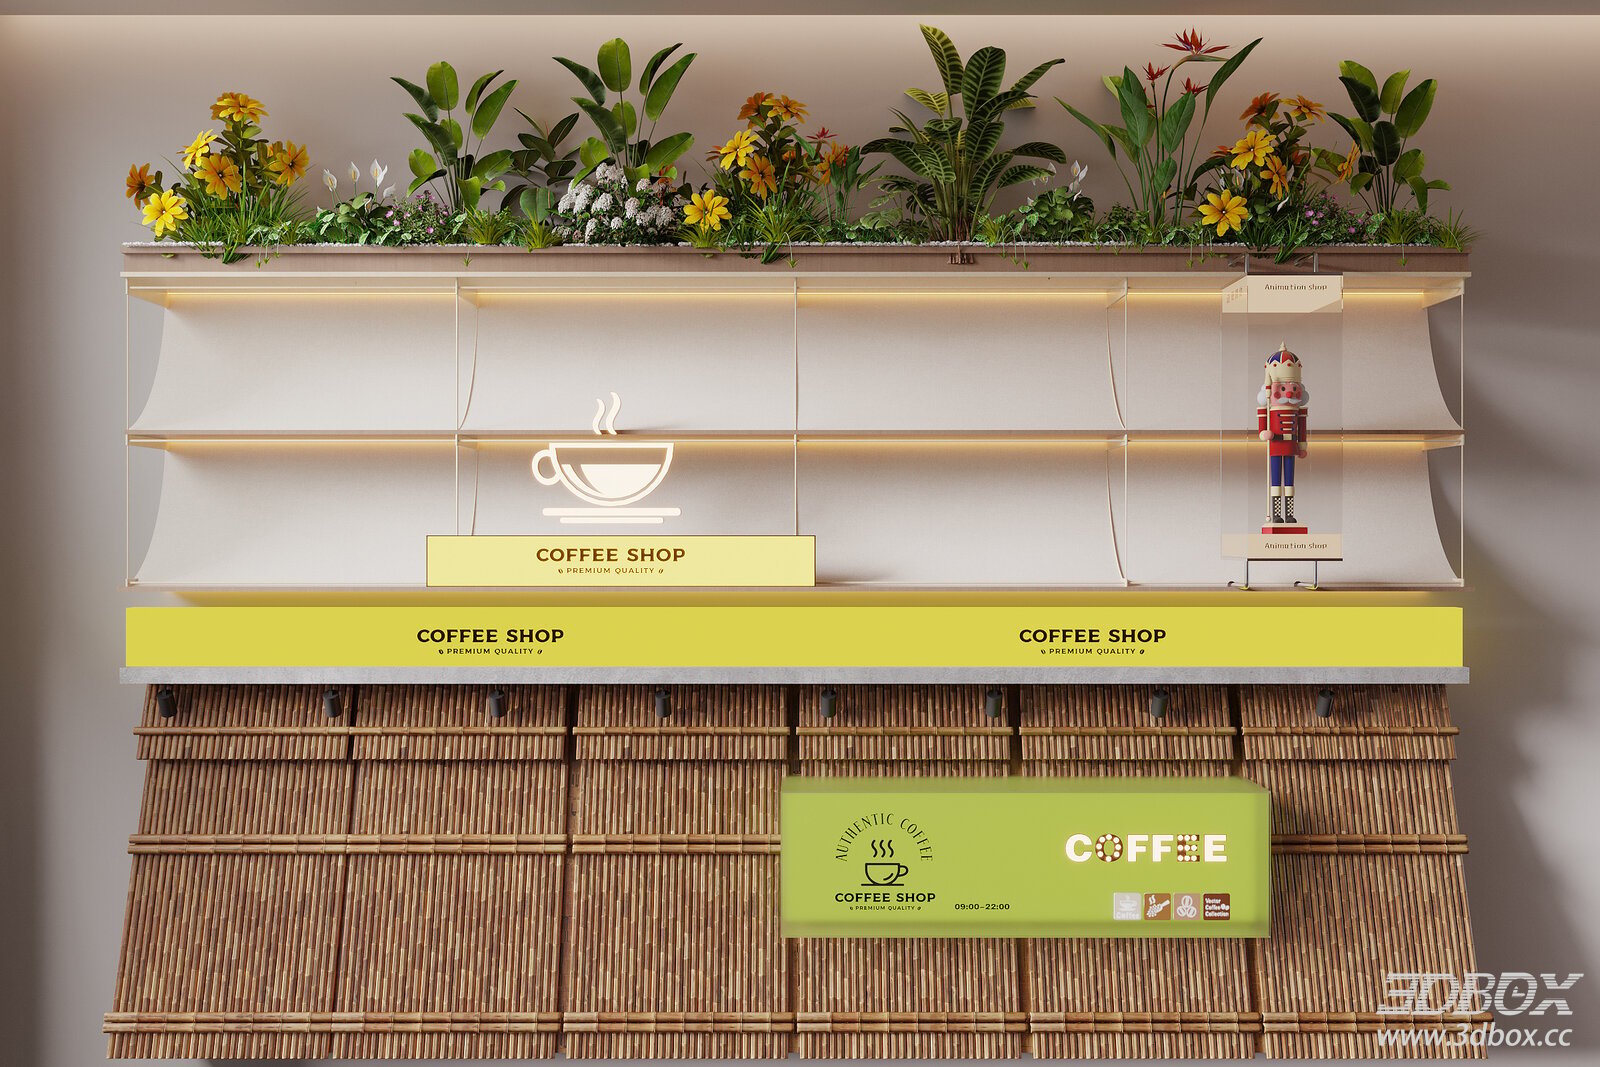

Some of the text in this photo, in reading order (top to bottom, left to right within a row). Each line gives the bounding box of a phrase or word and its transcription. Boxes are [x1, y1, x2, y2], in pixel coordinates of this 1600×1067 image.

[536, 548, 685, 562] COFFEE SHOP
[614, 567, 655, 575] QUALITY
[417, 629, 564, 643] COFFEE SHOP
[1019, 629, 1166, 643] COFFEE SHOP
[494, 648, 533, 656] QUALITY
[1096, 648, 1136, 656] QUALITY
[835, 812, 934, 862] AUTHENTIC COFFEE
[1065, 833, 1228, 863] COFFEE
[834, 892, 936, 903] COFFEE SHOP
